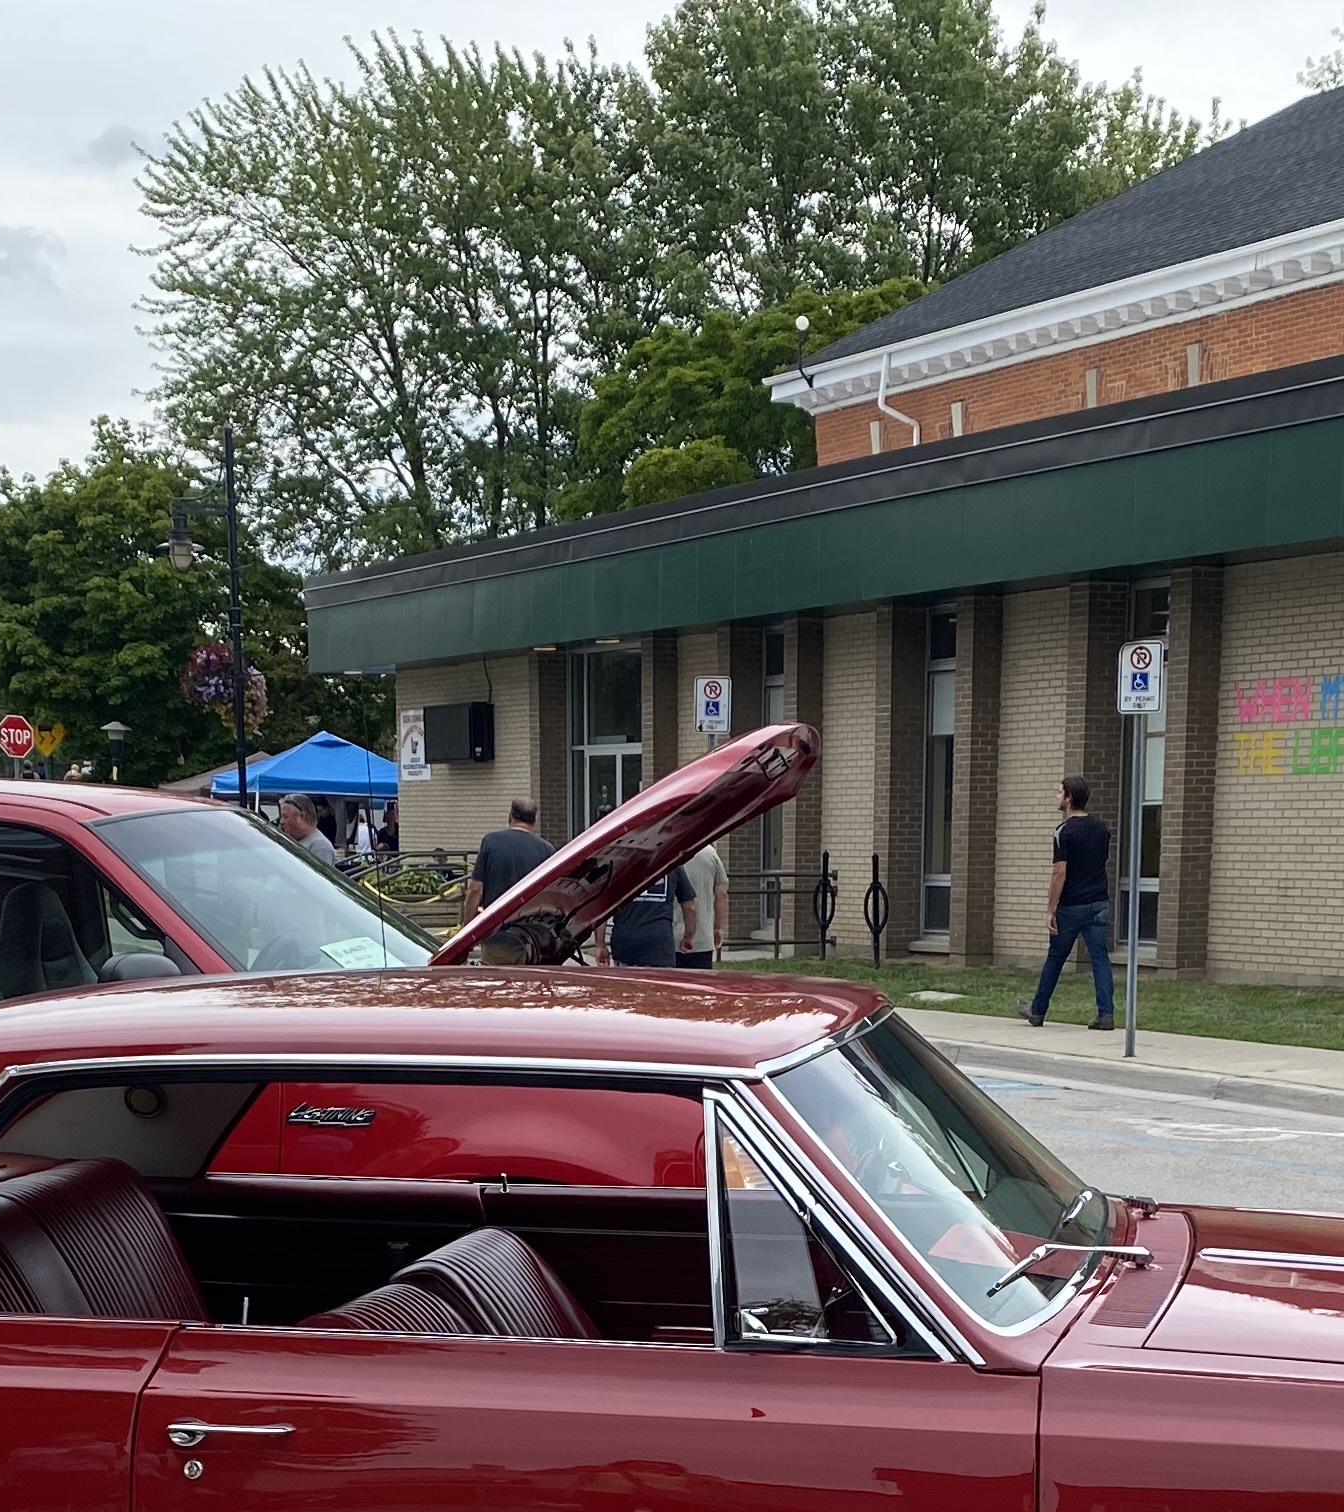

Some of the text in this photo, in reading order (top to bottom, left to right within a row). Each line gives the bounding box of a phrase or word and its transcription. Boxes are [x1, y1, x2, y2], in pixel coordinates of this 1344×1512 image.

[1235, 676, 1313, 723] WHEN
[0, 727, 31, 745] STOP
[1234, 730, 1285, 775] THE
